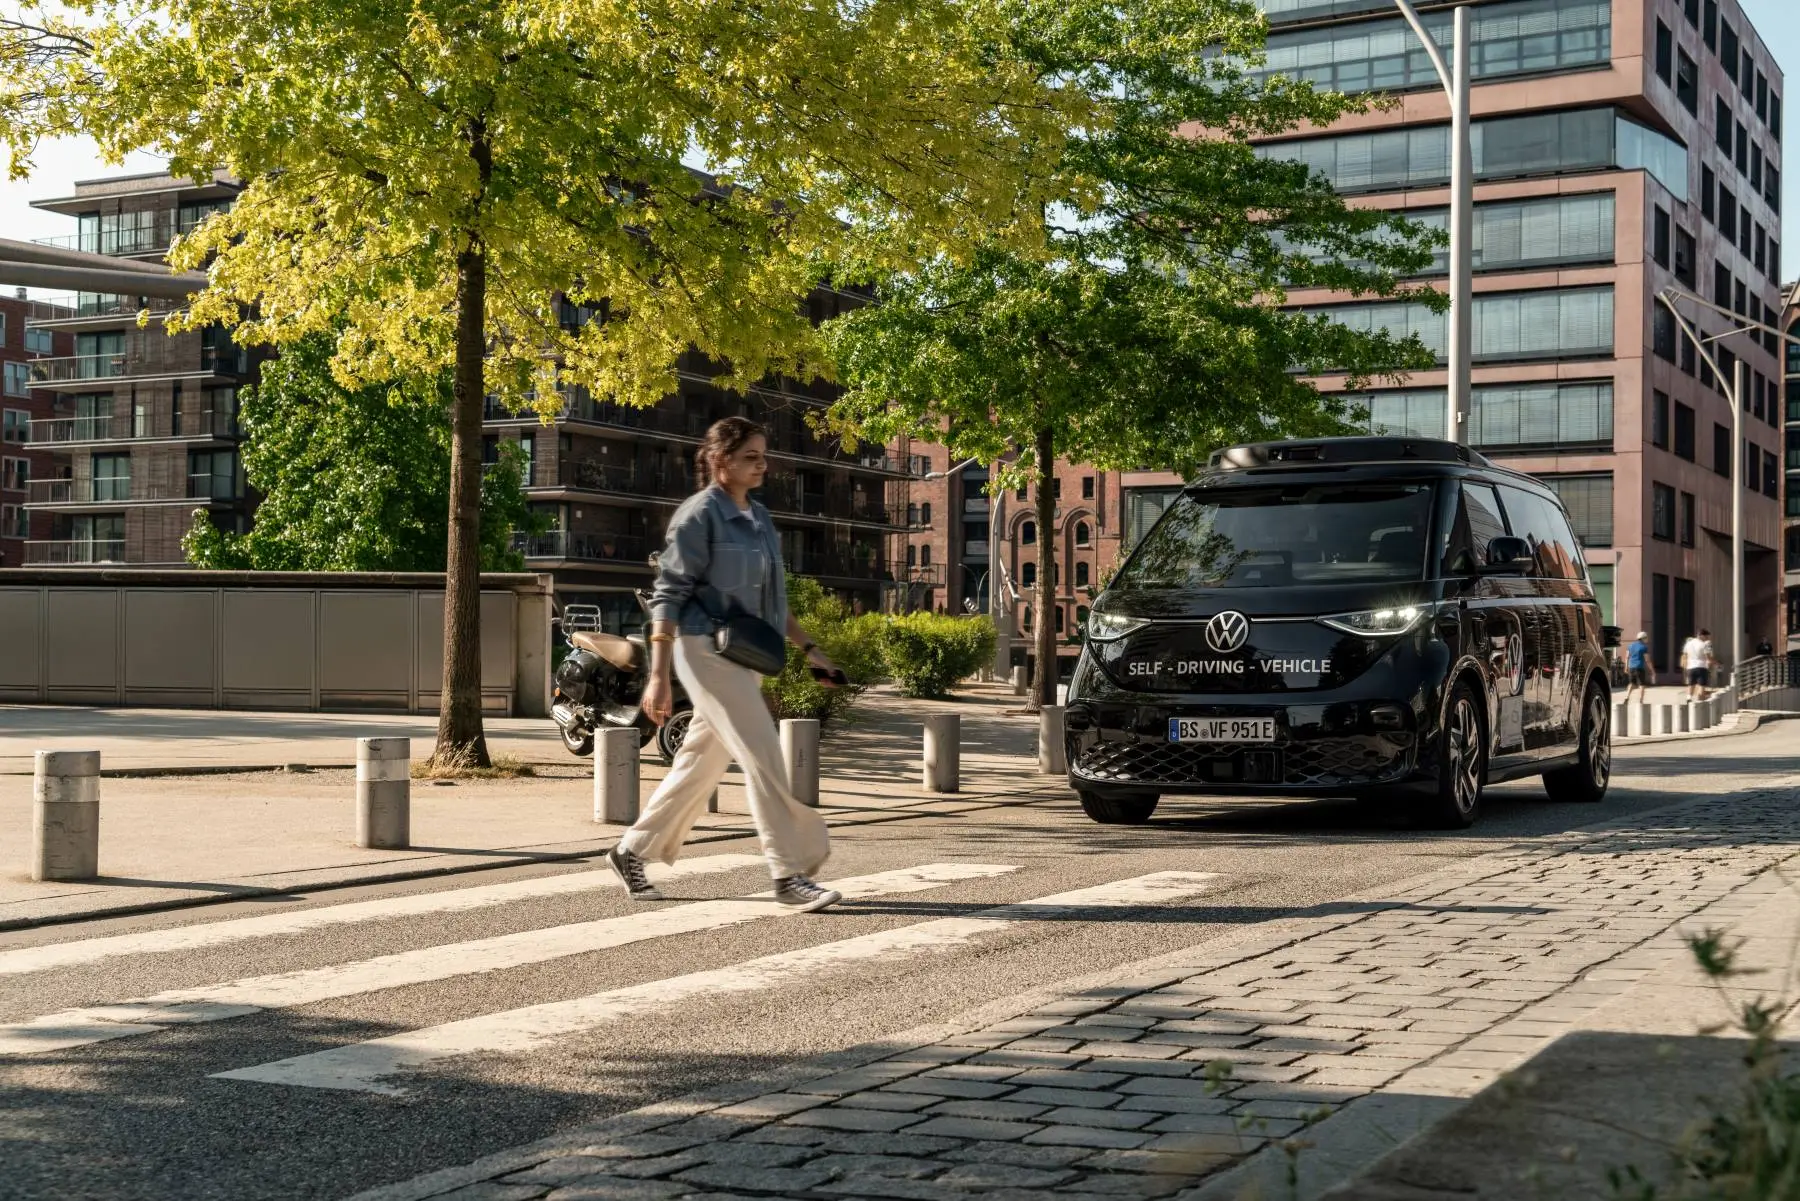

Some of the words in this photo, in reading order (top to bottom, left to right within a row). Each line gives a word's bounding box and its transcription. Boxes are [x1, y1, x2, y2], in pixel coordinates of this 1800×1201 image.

[1206, 611, 1249, 652] VW
[1128, 662, 1162, 675] SELF
[1177, 660, 1244, 675] DRIVING
[1260, 659, 1331, 673] VEHICLE
[1179, 721, 1199, 739] BS
[1209, 721, 1228, 739] VF
